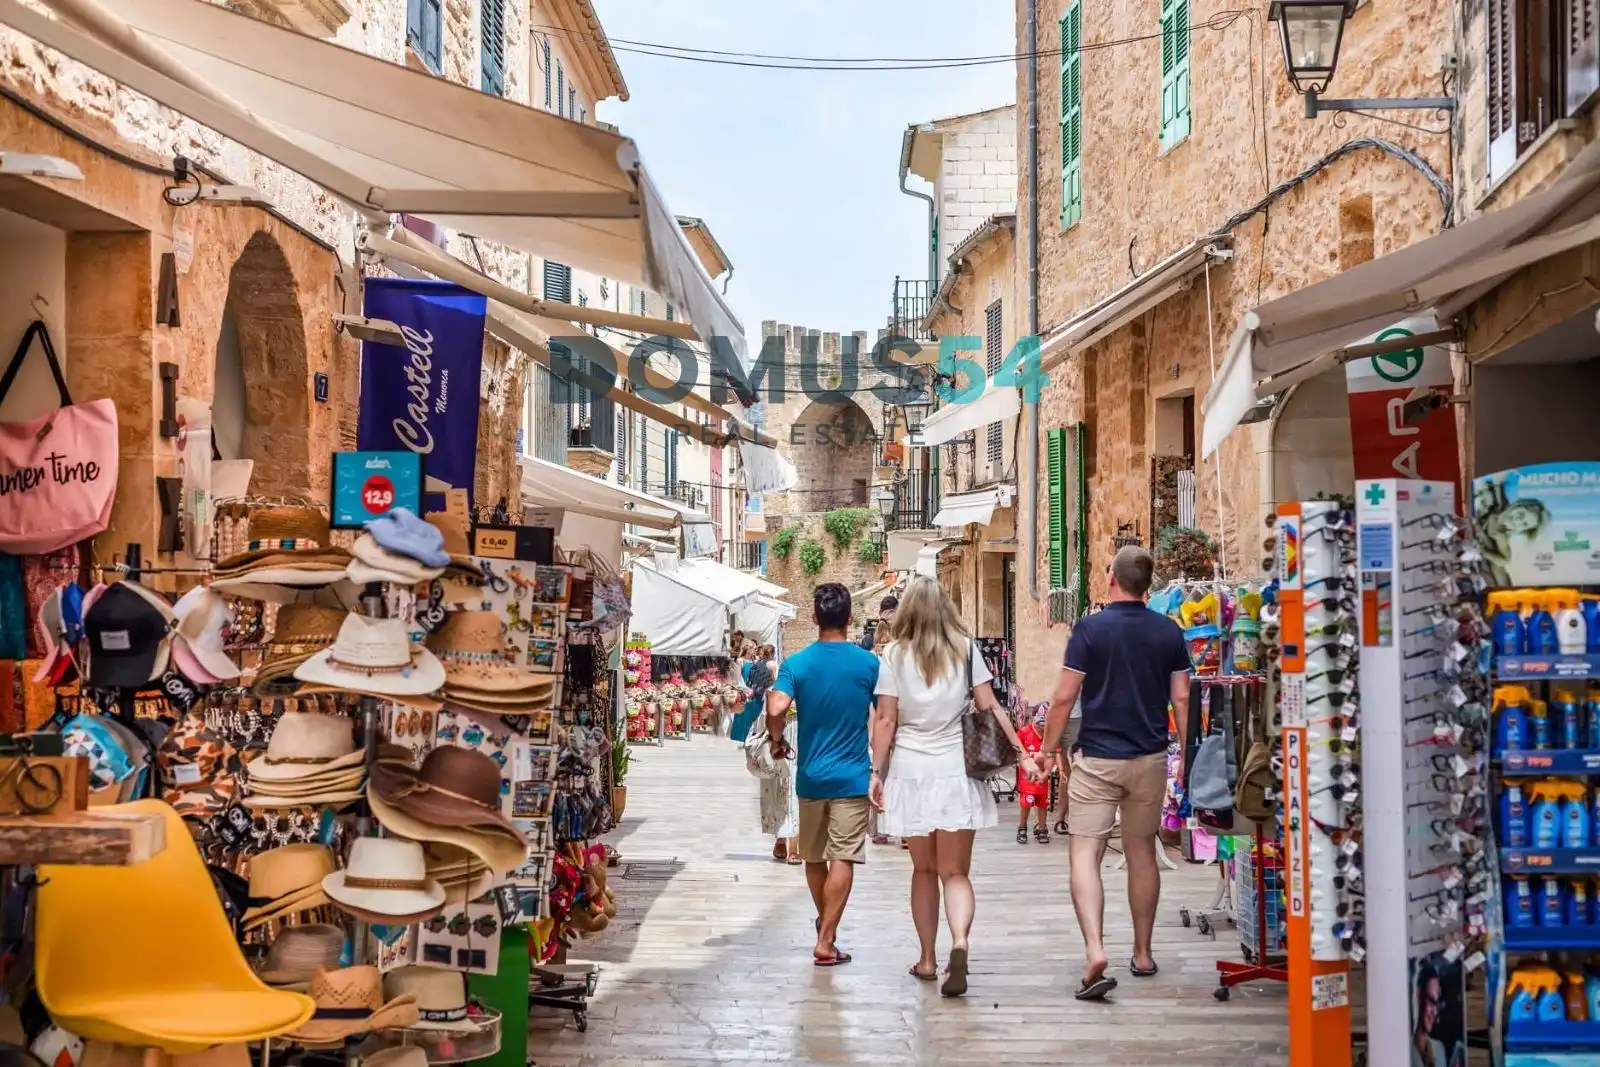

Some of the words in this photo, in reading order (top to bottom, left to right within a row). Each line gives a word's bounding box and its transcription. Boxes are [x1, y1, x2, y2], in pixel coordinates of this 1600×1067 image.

[393, 325, 434, 454] Castell
[44, 451, 100, 485] time
[1519, 471, 1580, 486] MUCHO
[1289, 734, 1302, 912] POLARIZED
